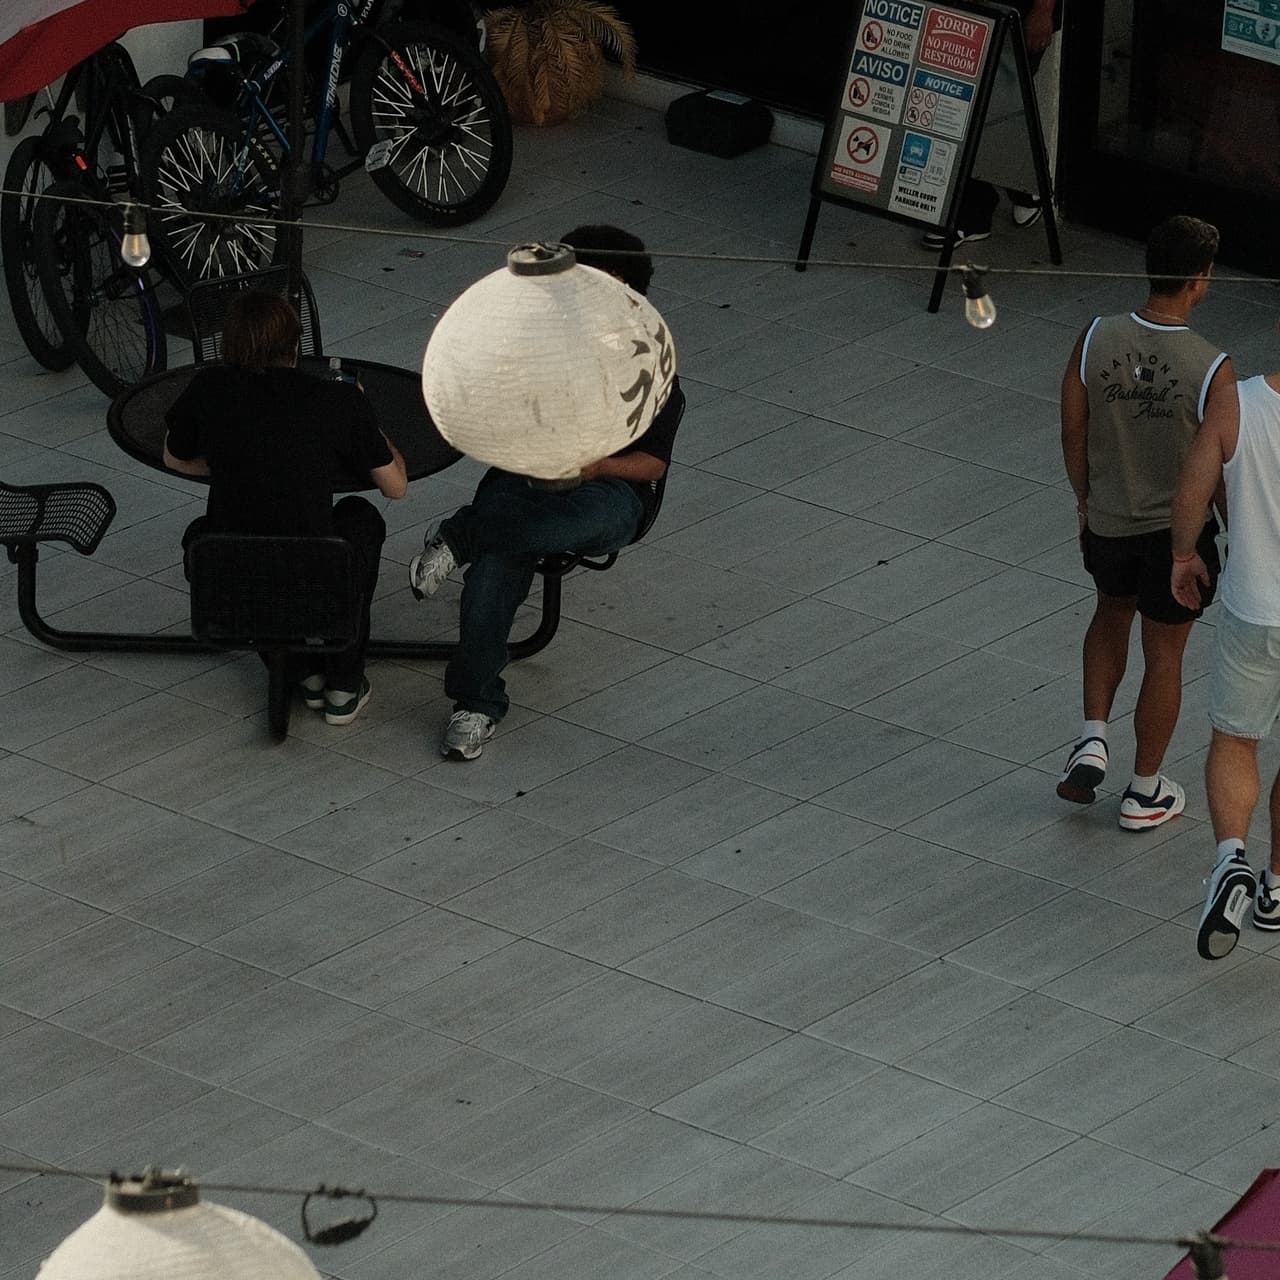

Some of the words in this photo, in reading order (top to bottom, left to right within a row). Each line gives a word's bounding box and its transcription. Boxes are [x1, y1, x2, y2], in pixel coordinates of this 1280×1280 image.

[886, 28, 895, 37] NO
[895, 30, 913, 42] FOOD
[935, 15, 978, 39] SORRY
[880, 46, 910, 60] ALLOWED
[883, 37, 892, 46] NO
[892, 40, 911, 51] DRINK
[926, 36, 941, 49] NO
[942, 40, 976, 58] PUBLIC
[856, 56, 904, 82] AVISO
[923, 49, 976, 72] RESTROOM
[924, 76, 964, 96] NOTICE
[894, 195, 919, 209] PARKING
[898, 186, 918, 199] WELLER
[1100, 352, 1184, 400] NATIONAL
[1103, 383, 1171, 403] Basketball
[1133, 401, 1174, 420] Assoc
